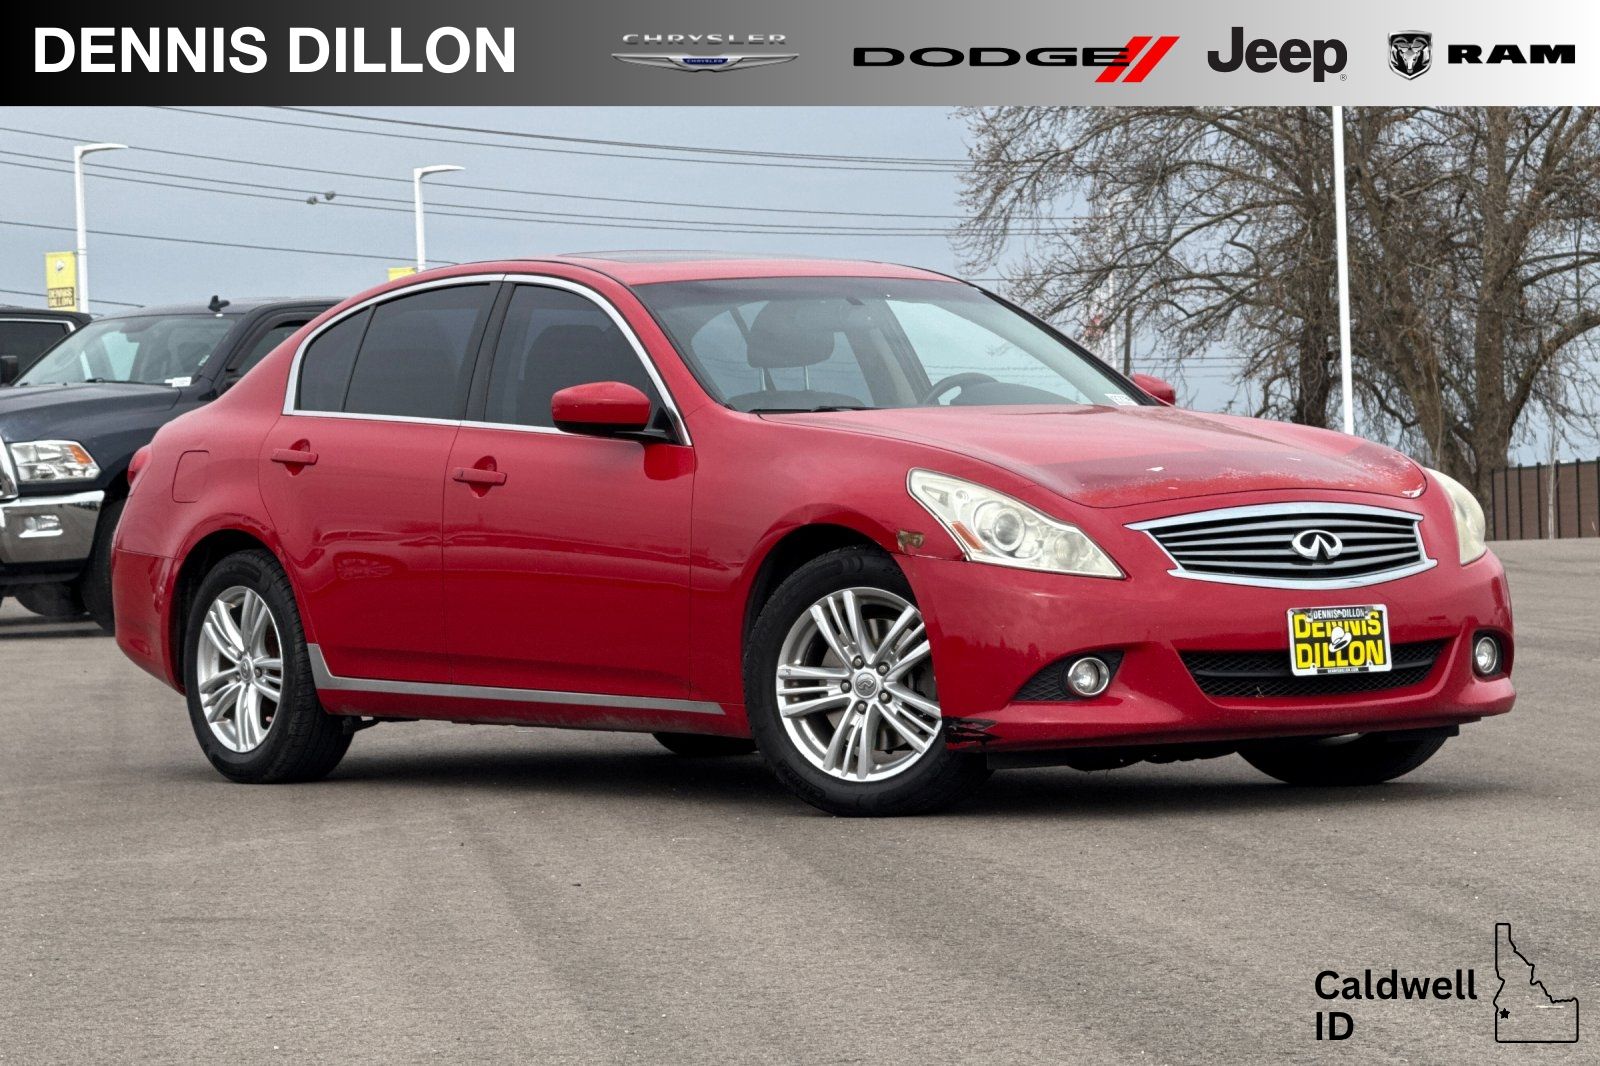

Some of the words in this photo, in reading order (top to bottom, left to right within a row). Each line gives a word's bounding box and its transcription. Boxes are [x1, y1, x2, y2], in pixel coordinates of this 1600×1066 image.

[1313, 609, 1338, 619] DENNIS
[1342, 608, 1365, 618] DILLON
[1295, 639, 1384, 669] DILLON
